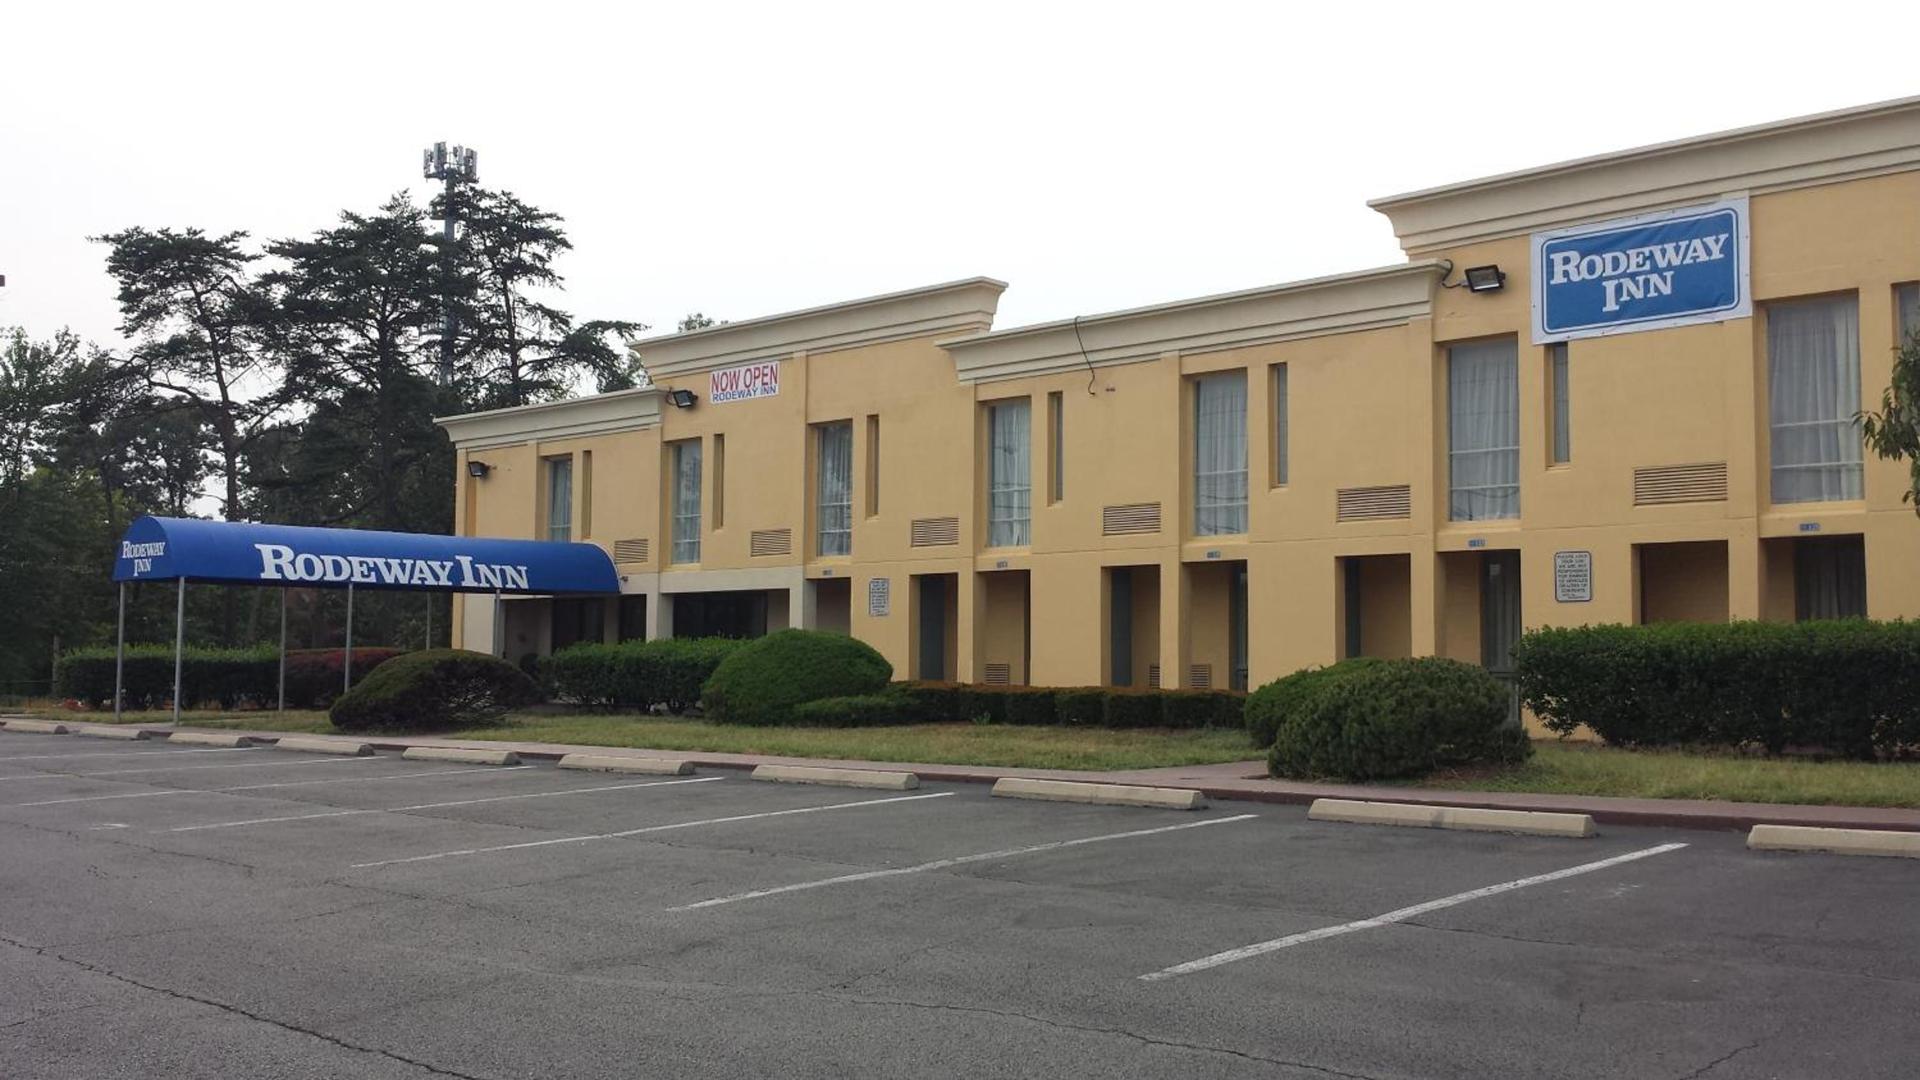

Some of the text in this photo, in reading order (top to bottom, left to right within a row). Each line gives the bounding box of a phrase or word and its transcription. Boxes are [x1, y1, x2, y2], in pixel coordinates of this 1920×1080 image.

[1550, 233, 1729, 285] RODEWAY
[1602, 270, 1674, 312] INN
[712, 363, 778, 393] NOW OPEN
[713, 385, 776, 402] RODEWAY INN
[121, 540, 166, 560] RODEWAY
[133, 557, 153, 577] INN
[254, 543, 529, 590] RODEWAY INN
